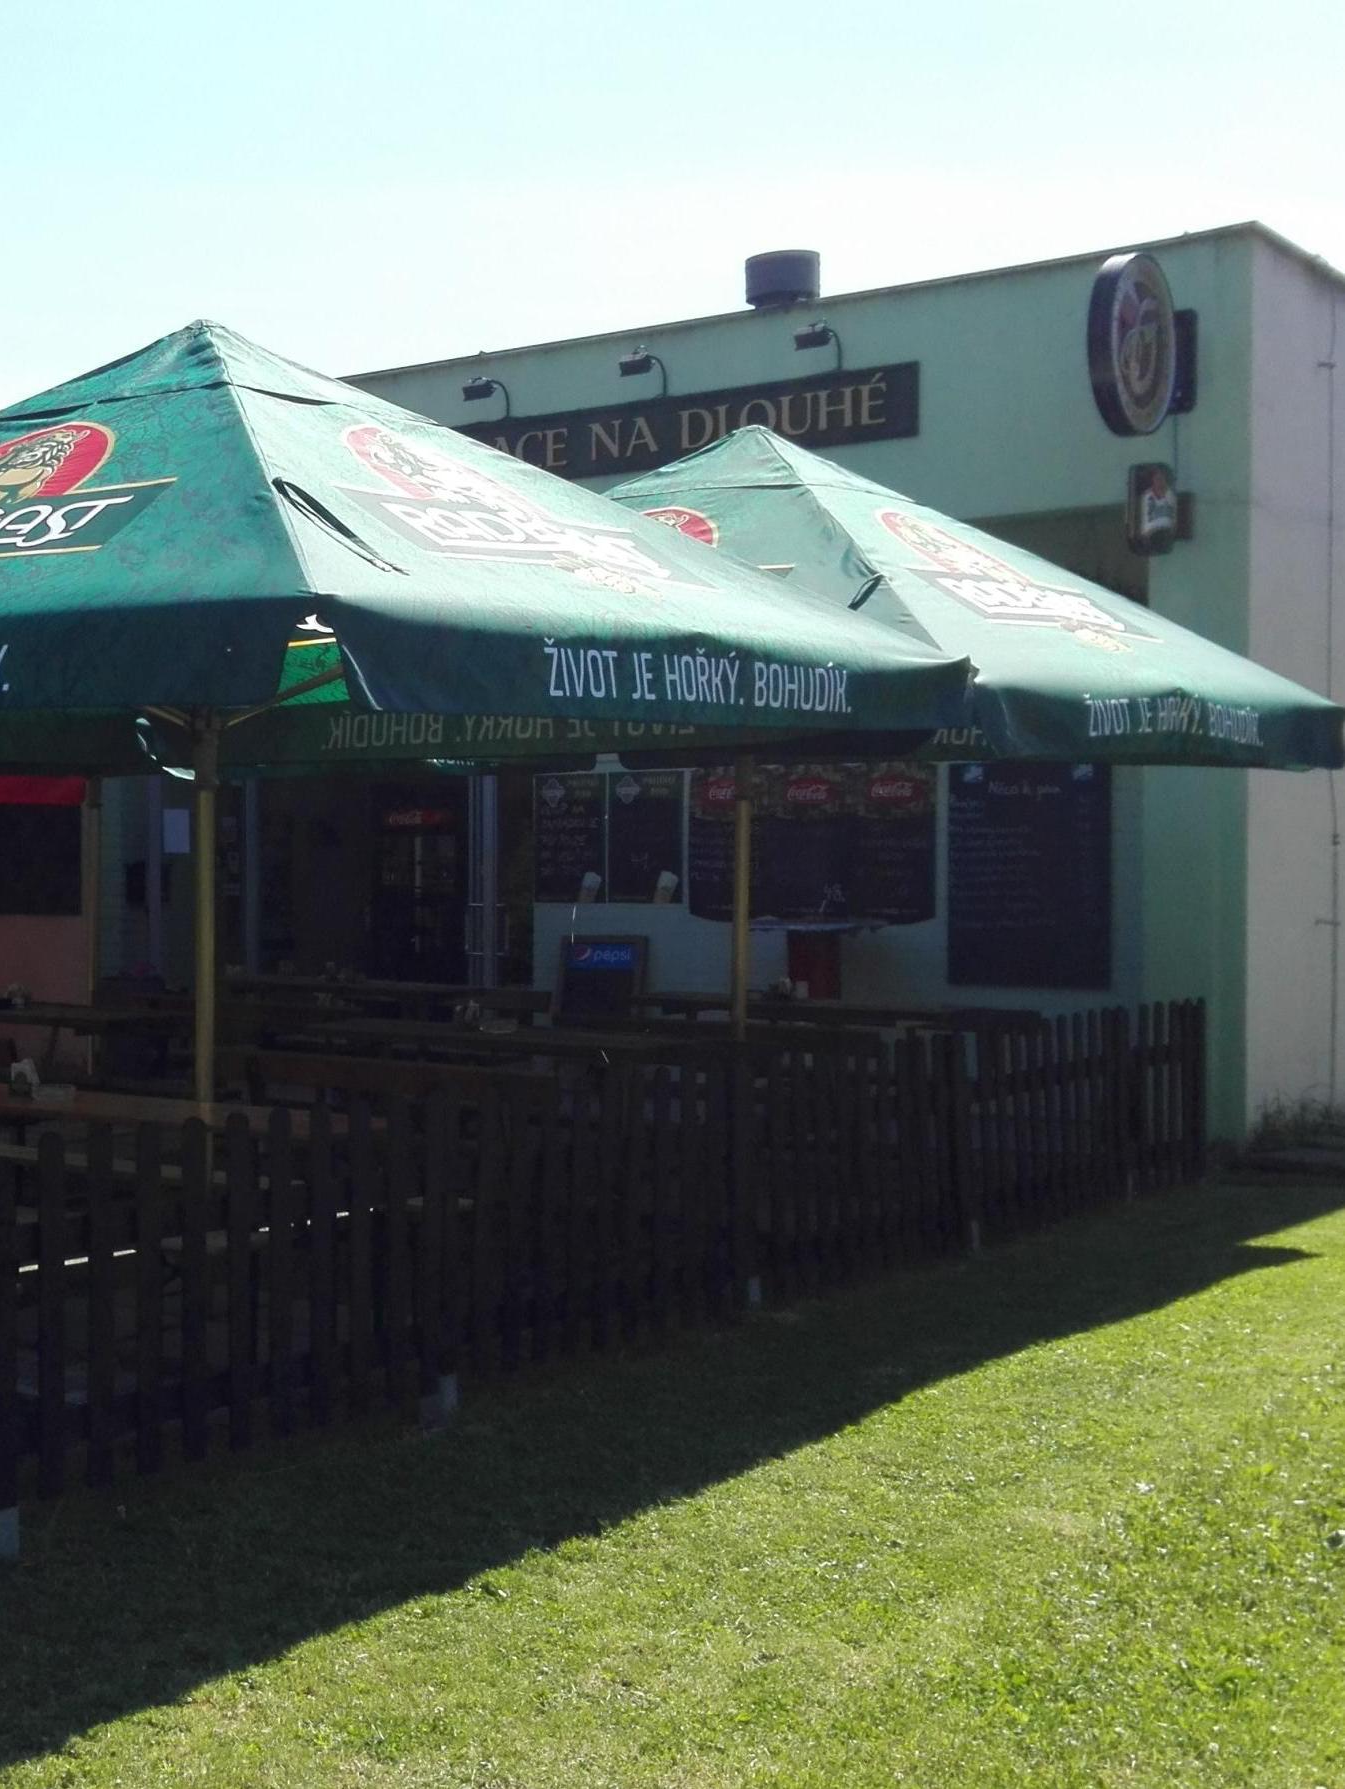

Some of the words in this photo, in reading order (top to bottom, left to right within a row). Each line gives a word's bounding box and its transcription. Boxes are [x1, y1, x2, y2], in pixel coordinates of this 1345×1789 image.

[589, 416, 659, 461] NA
[543, 637, 618, 699] ŽIVOT
[632, 652, 656, 701] JE
[663, 646, 745, 706] HOŘKÝ.
[754, 661, 853, 713] BOHUDÍK.
[1083, 692, 1130, 738] ŽIVOT
[1138, 697, 1153, 735] JE
[593, 947, 632, 963] pepsi
